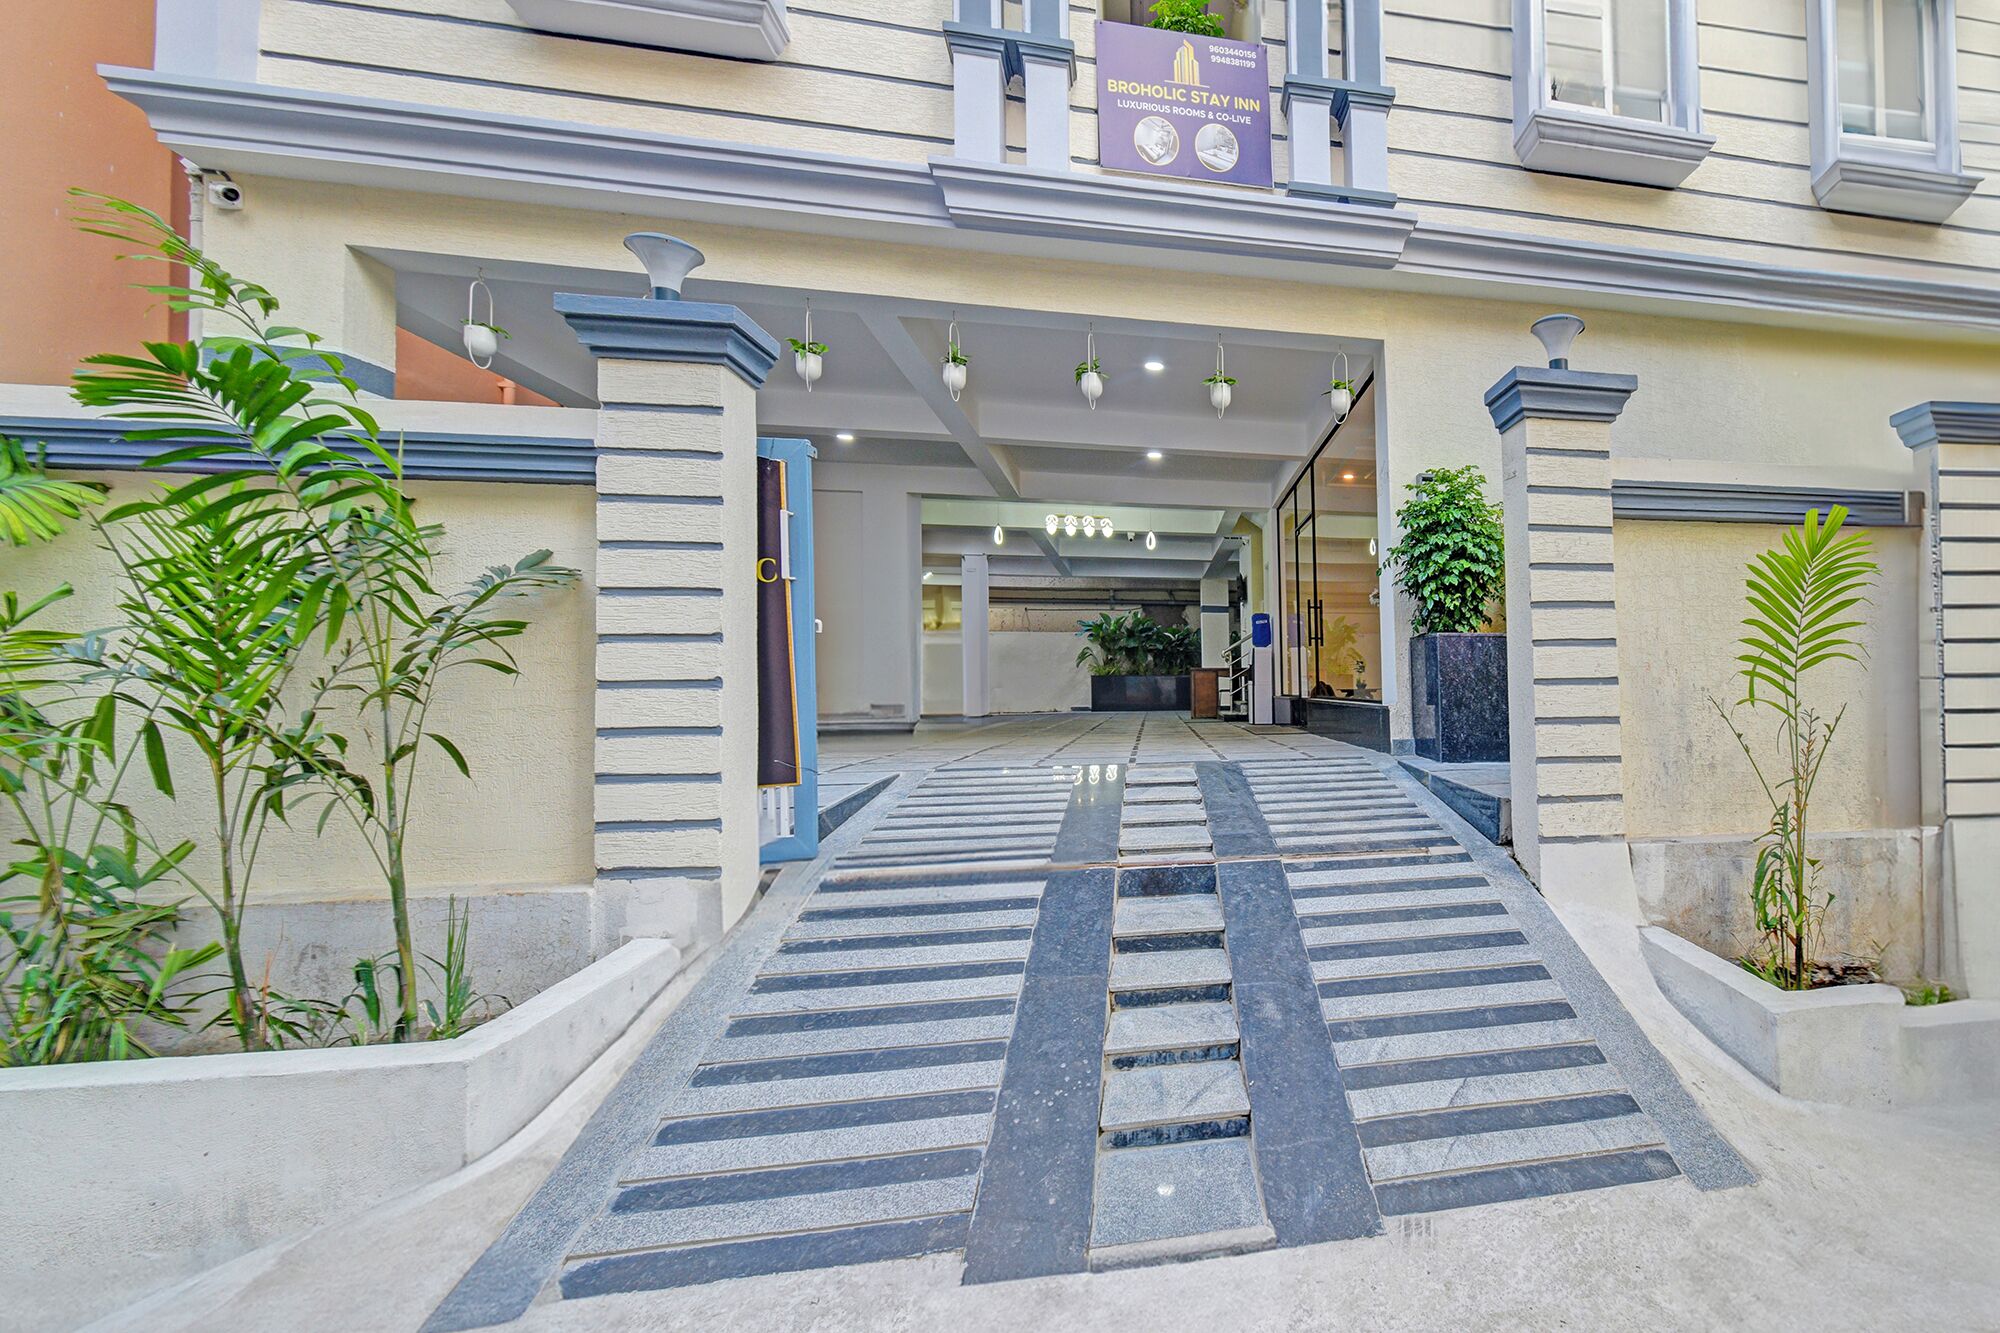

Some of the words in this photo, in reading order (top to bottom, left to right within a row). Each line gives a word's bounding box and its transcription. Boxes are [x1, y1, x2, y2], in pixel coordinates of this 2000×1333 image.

[1208, 45, 1257, 59] 9603440156
[1210, 54, 1256, 69] 9948381199
[1107, 79, 1187, 102] BROHOLIC
[1190, 91, 1230, 108] STAY
[1233, 98, 1261, 112] INN
[1117, 99, 1171, 114] LUXURIOUS
[1172, 106, 1206, 119] ROOMS
[1208, 111, 1214, 120] &
[1216, 113, 1252, 125] CO-LIVE
